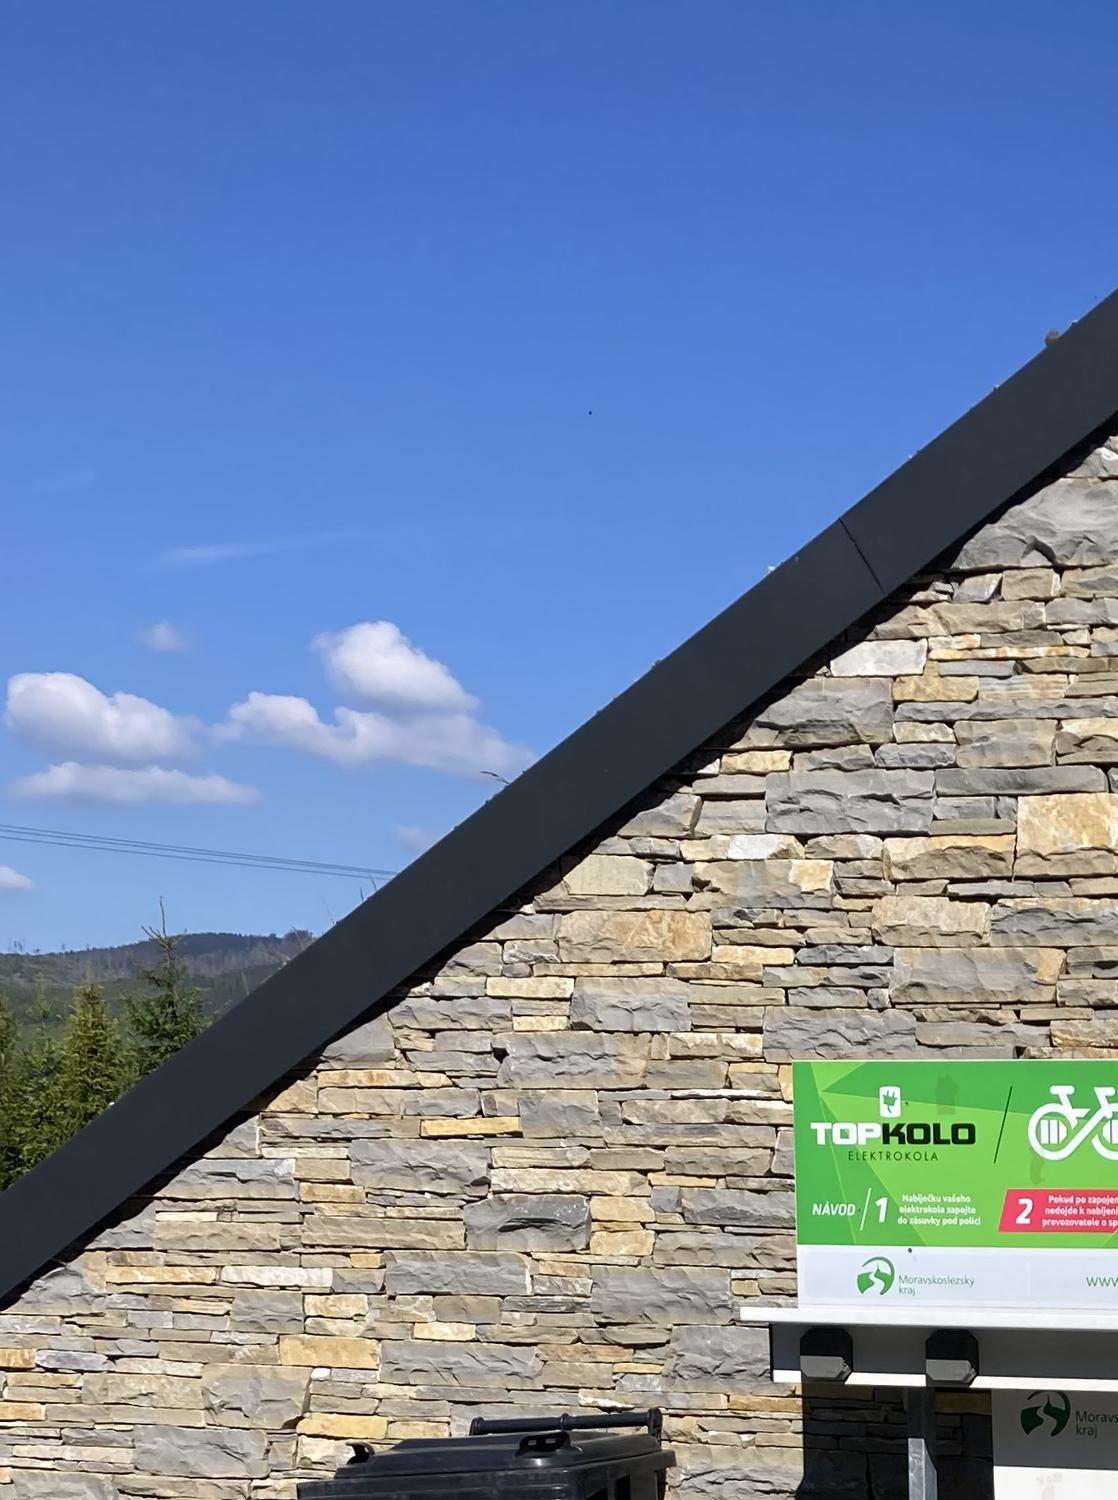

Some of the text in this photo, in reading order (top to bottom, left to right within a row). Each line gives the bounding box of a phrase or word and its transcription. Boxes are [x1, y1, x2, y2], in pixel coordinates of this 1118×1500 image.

[810, 1122, 976, 1145] TOPKOLO
[848, 1151, 938, 1162] ELEKTROKOLA
[902, 1193, 942, 1204] Nabíječku
[1048, 1195, 1074, 1204] Pokud
[1076, 1198, 1086, 1206] po
[812, 1199, 856, 1216] NÁVOD
[875, 1198, 888, 1223] 1
[899, 1205, 976, 1215] elektrokola zapojte
[1016, 1198, 1033, 1225] 2
[1045, 1207, 1078, 1217] nedojde
[1080, 1207, 1085, 1215] k
[897, 1216, 908, 1225] do
[909, 1216, 940, 1226] zásuvky
[942, 1217, 957, 1226] pod
[1042, 1217, 1100, 1228] provozovatele
[898, 1274, 975, 1287] Moravskoslezský
[898, 1285, 916, 1296] kraj
[1075, 1425, 1098, 1439] kraj
